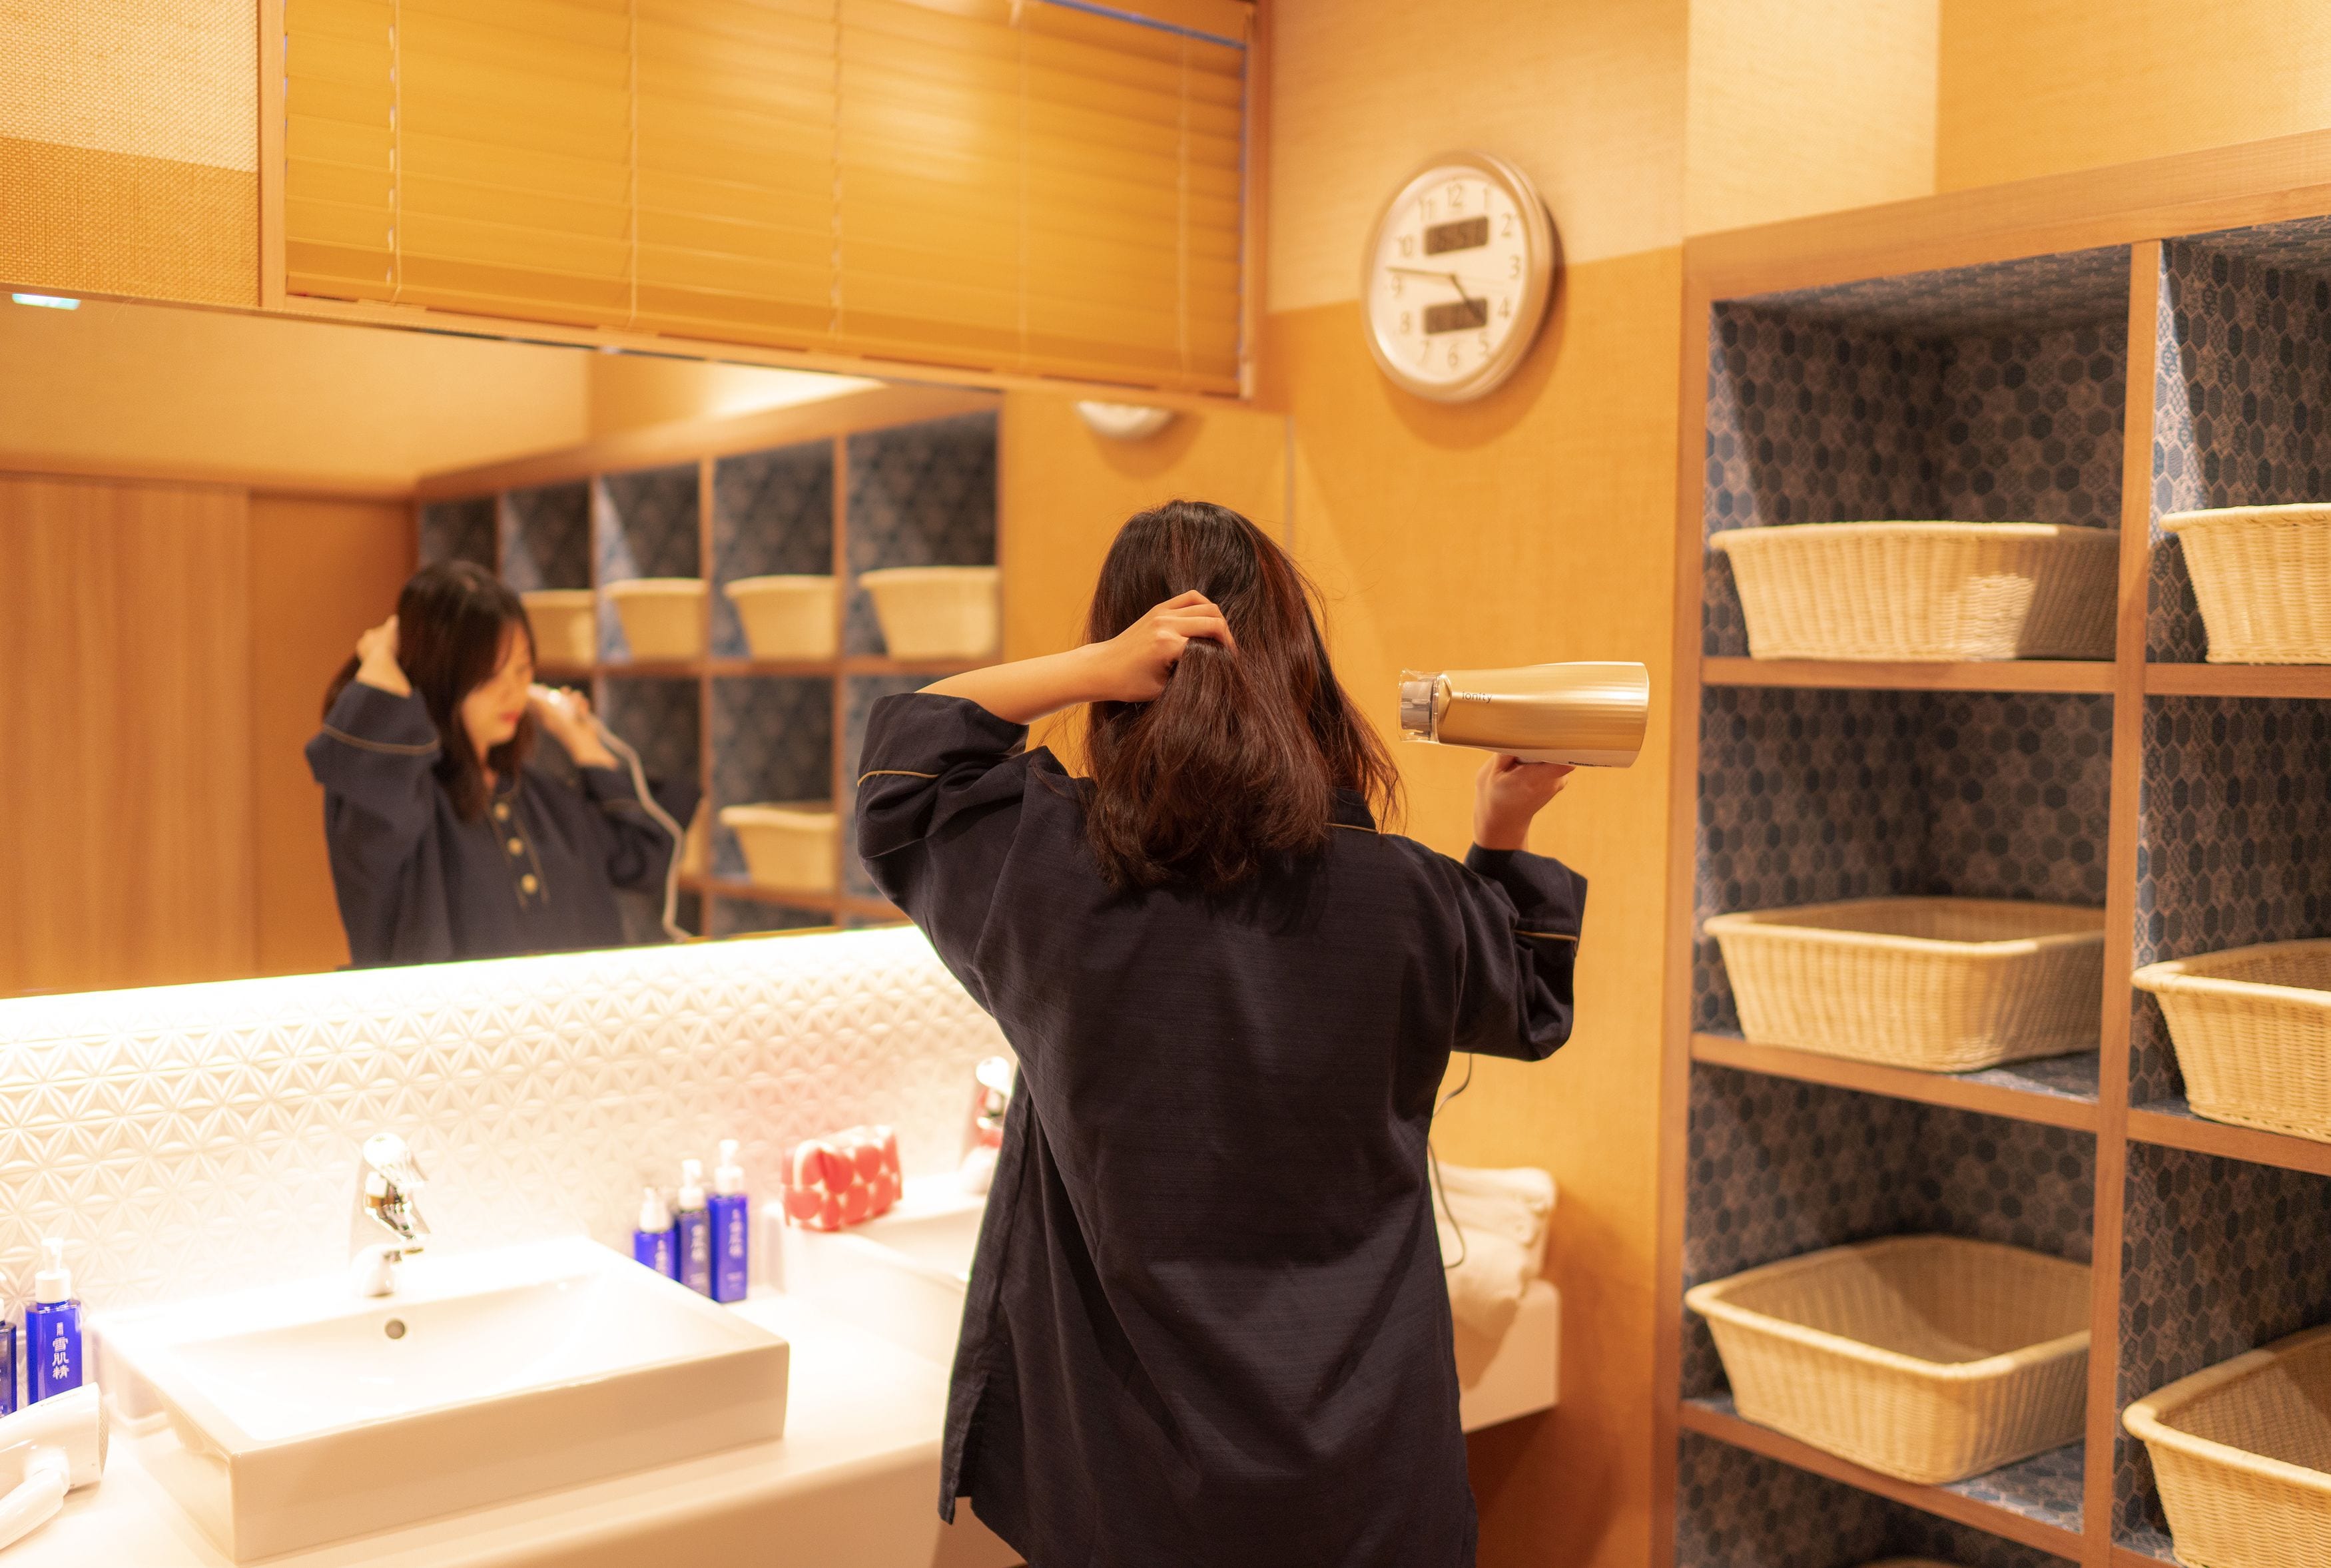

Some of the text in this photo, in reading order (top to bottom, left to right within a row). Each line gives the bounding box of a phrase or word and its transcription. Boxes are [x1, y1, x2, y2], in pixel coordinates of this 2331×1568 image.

[1447, 183, 1464, 208] 12
[1483, 188, 1491, 210] 1
[1419, 198, 1435, 220] 11
[1500, 213, 1512, 238] 2
[1398, 236, 1413, 257] 10
[1509, 255, 1521, 279] 3
[1391, 276, 1403, 299] 9
[1498, 297, 1510, 319] 4
[1400, 311, 1411, 335] 8
[1417, 340, 1431, 366] 7
[1447, 344, 1460, 369] 6
[1479, 334, 1489, 357] 5
[1462, 691, 1493, 704] ionity
[52, 1336, 70, 1380] 雪肌精
